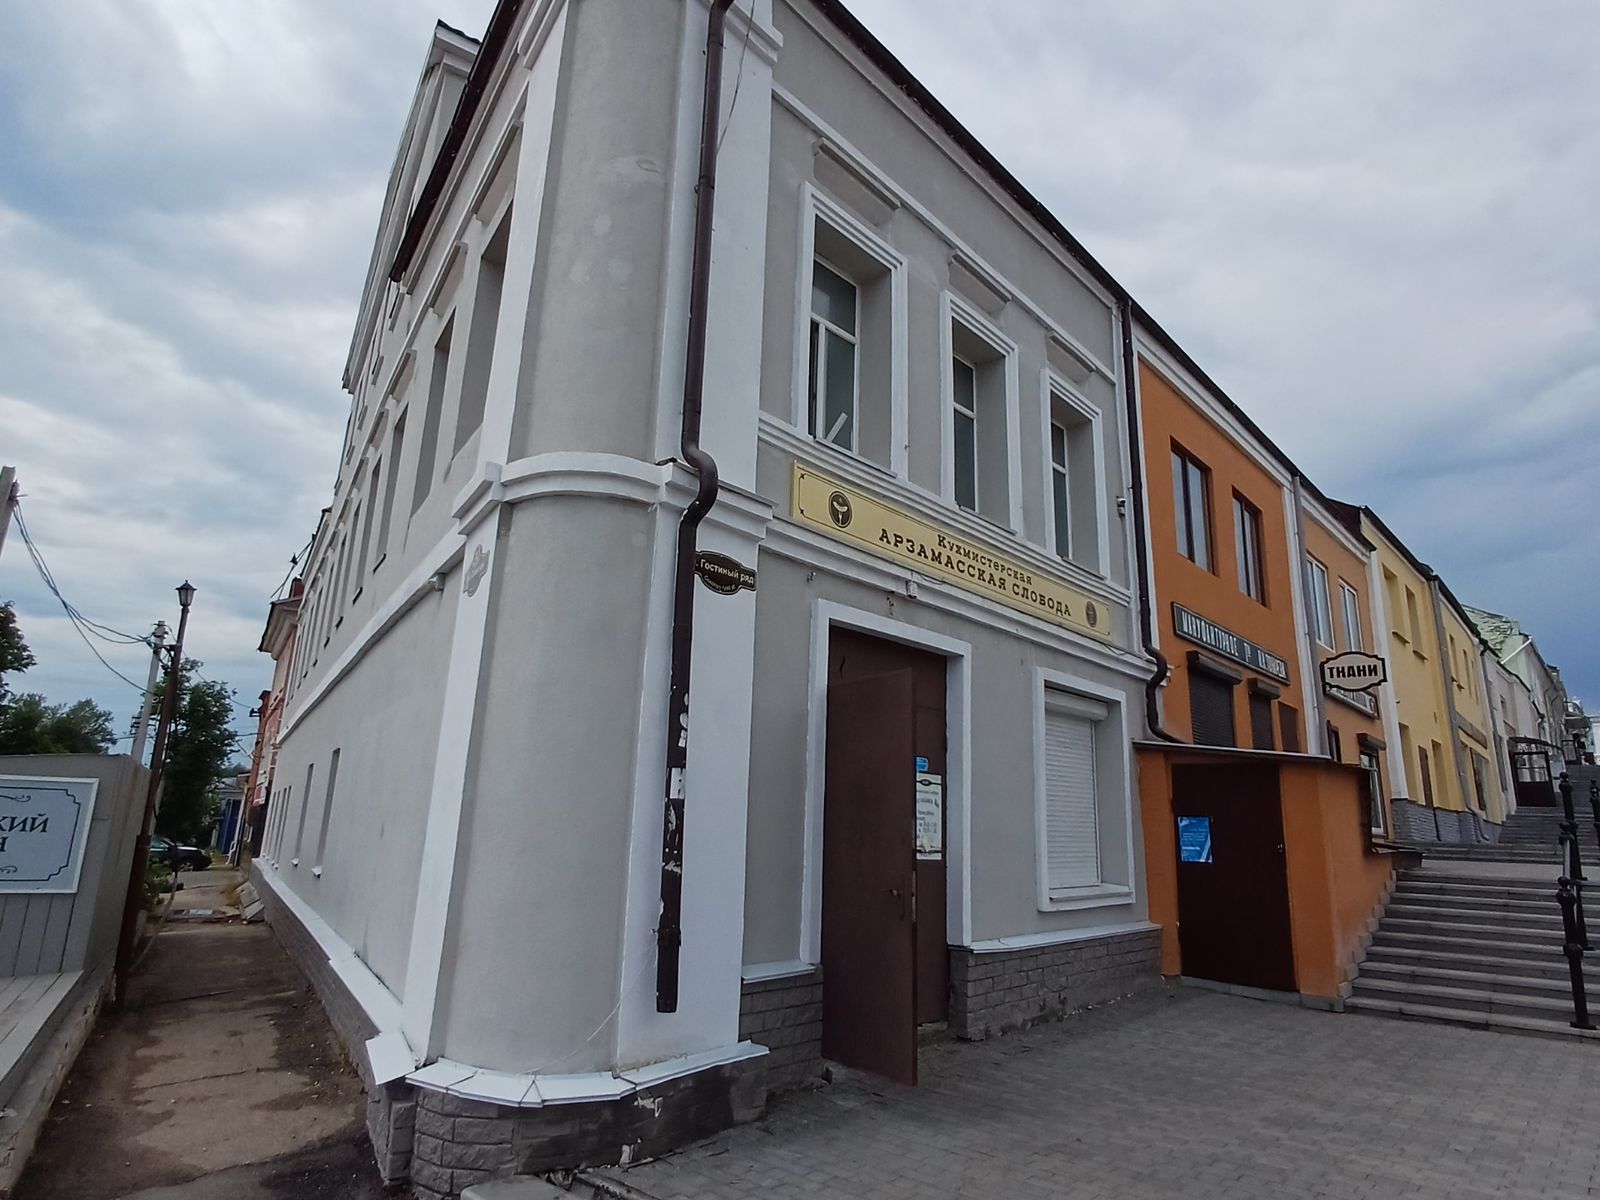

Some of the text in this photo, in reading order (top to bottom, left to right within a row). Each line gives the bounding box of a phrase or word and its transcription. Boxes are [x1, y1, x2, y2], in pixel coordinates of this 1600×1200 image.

[700, 559, 739, 579] Гостиный
[740, 573, 754, 584] ряд
[878, 528, 1071, 617] АРЗАМАССКАЯ СЛОБОДА
[937, 534, 1032, 586] Кухмистерская
